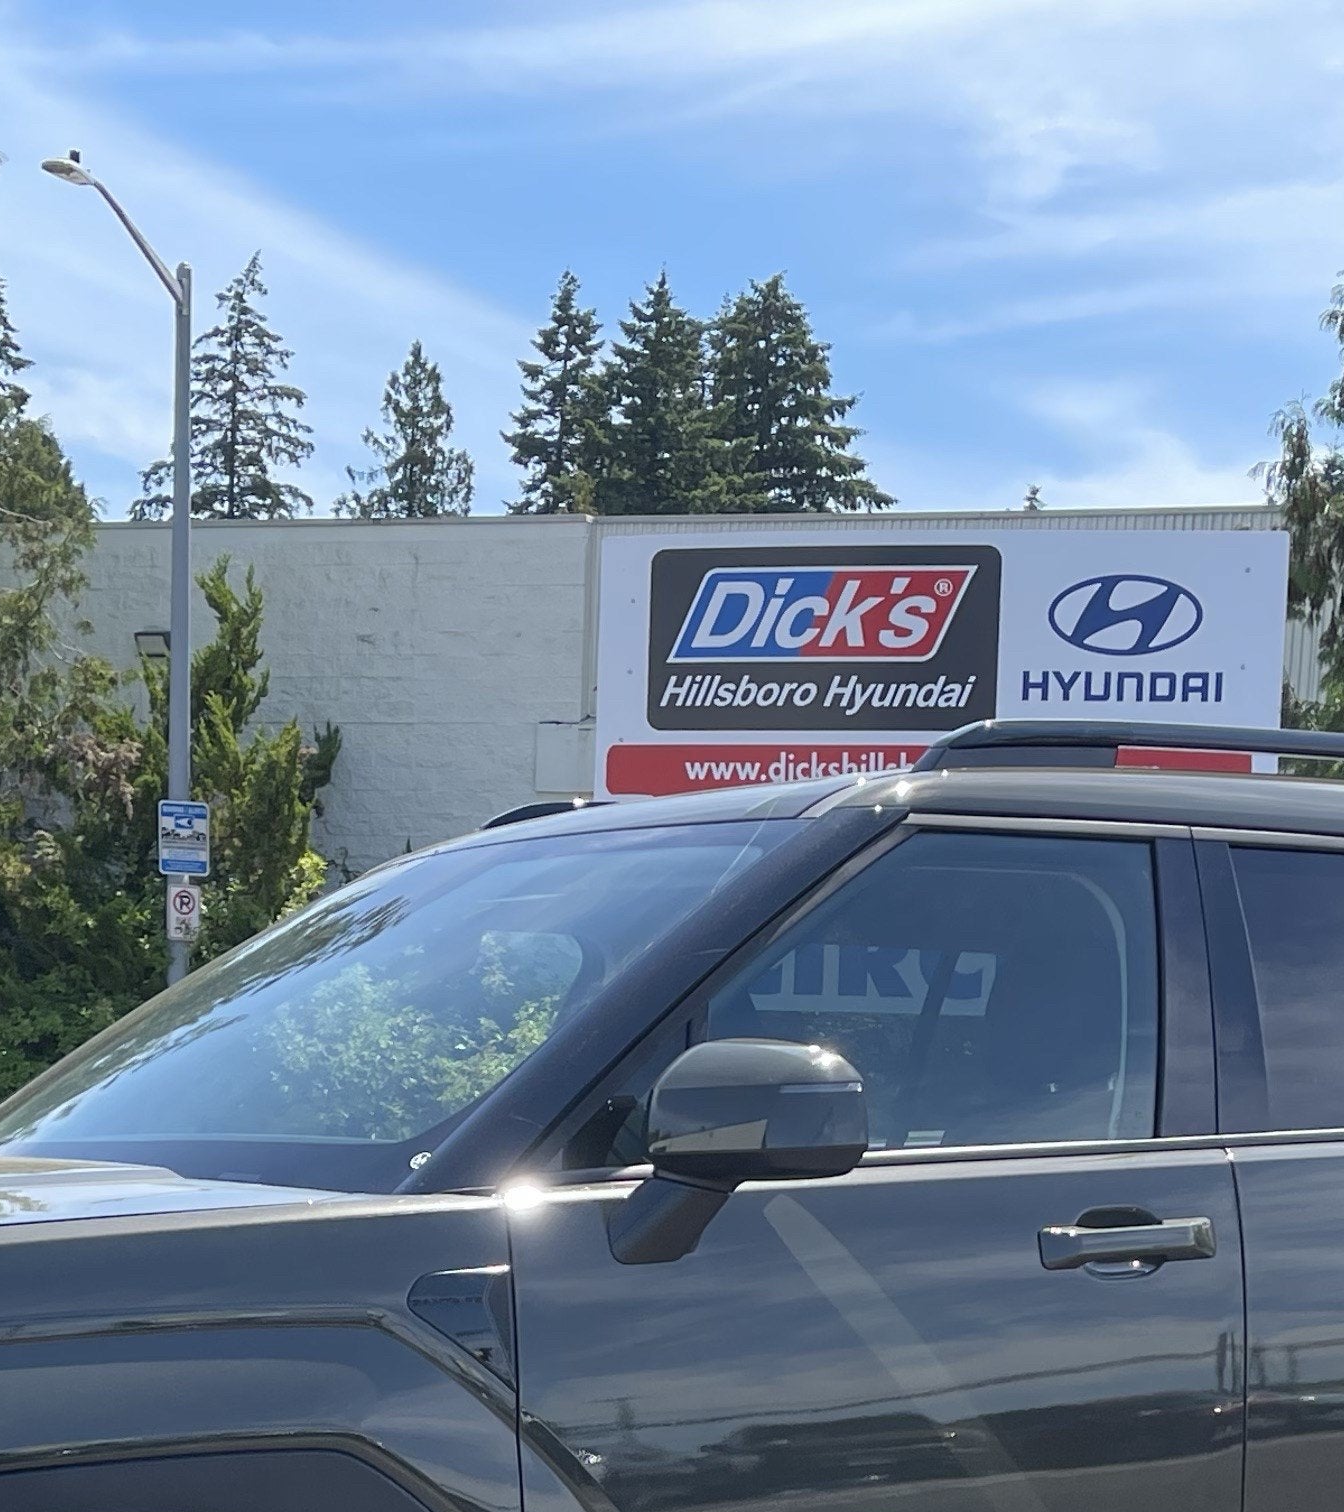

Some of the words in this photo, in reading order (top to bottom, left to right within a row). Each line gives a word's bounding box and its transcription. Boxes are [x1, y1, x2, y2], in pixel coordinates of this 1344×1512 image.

[659, 674, 818, 708] Hillsboro
[822, 674, 977, 717] Hyundai
[1021, 671, 1224, 703] HYUNDAI
